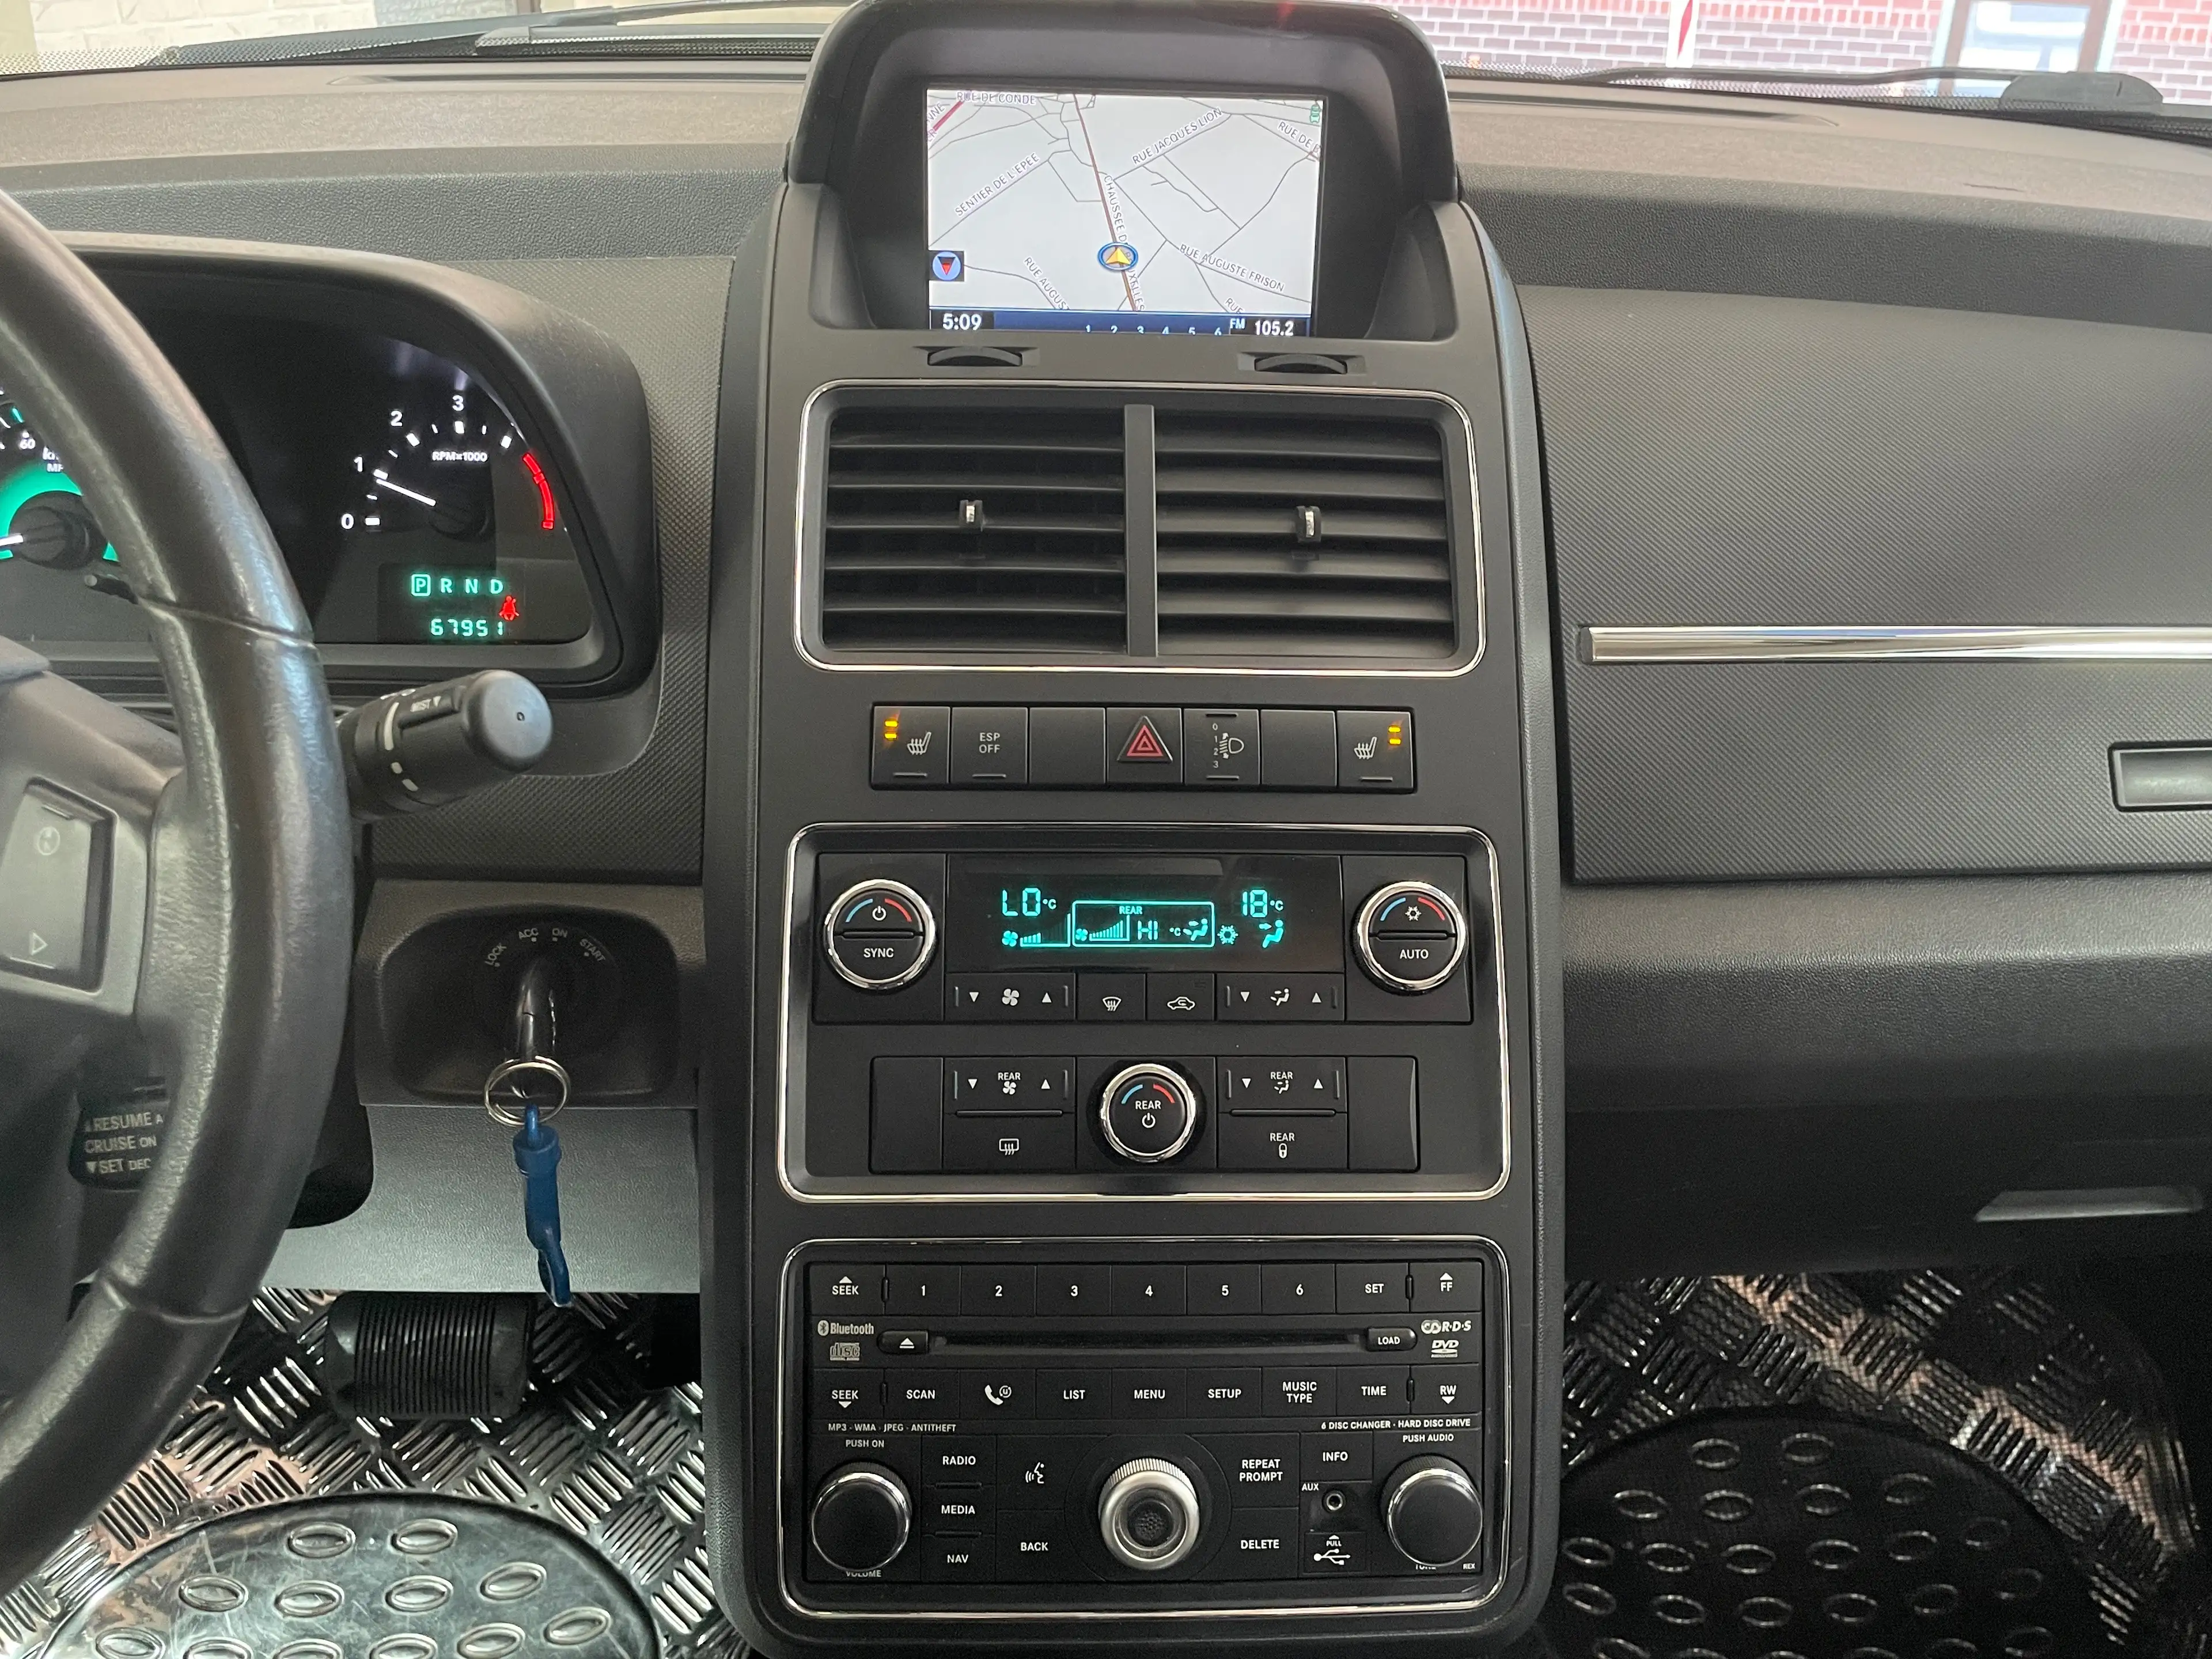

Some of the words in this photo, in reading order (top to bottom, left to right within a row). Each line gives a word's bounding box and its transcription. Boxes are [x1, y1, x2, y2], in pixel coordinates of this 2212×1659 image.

[957, 92, 977, 101] RUE
[982, 93, 993, 102] DE
[998, 93, 1036, 104] CONDE
[1132, 149, 1153, 164] RUE
[1154, 122, 1198, 154] JACQUES
[1199, 108, 1222, 127] LION
[1278, 122, 1297, 139] RUE
[1299, 134, 1312, 149] DE
[955, 186, 994, 216] SENTIER
[993, 175, 1007, 189] DE
[1007, 153, 1039, 179] L'EPEE
[1104, 175, 1126, 230] CHAUSSEE
[1024, 257, 1042, 278] RUE
[1180, 244, 1199, 259] RUE
[1202, 253, 1247, 277] AUGUSTE
[1249, 271, 1284, 292] FRISON
[1226, 298, 1243, 313] RUE
[942, 313, 982, 331] 5:09
[1230, 318, 1245, 329] FM
[1255, 320, 1294, 336] 105.2
[452, 395, 464, 411] 3
[390, 411, 403, 426] 2
[19, 438, 36, 449] 60
[354, 456, 363, 472] 1
[341, 513, 354, 529] 0
[416, 578, 426, 592] P
[440, 578, 452, 593] R
[465, 578, 478, 594] N
[490, 579, 503, 594] D
[431, 618, 503, 637] 67951
[1212, 722, 1218, 731] 0
[979, 732, 1001, 742] ESP
[1214, 735, 1218, 743] 1
[979, 744, 1001, 753] OFF
[1243, 889, 1268, 918] 18
[1119, 906, 1143, 915] REAR
[518, 927, 539, 940] ACC
[552, 927, 568, 938] ON
[484, 942, 507, 966] LOCK
[579, 938, 606, 962] START
[863, 948, 894, 958] SYNC
[1399, 949, 1429, 959] AUTO
[998, 1072, 1021, 1081] REAR
[1270, 1071, 1293, 1080] REAR
[1135, 1100, 1161, 1110] REAR
[92, 1112, 153, 1132] RESUME
[1270, 1132, 1295, 1142] REAR
[86, 1135, 136, 1154] CRUISE
[139, 1135, 157, 1149] ON
[99, 1158, 124, 1175] SET
[832, 1285, 859, 1295] SEEK
[921, 1285, 926, 1296] 1
[995, 1285, 1002, 1297] 2
[1070, 1285, 1078, 1297] 3
[1145, 1285, 1153, 1297] 4
[1221, 1285, 1229, 1296] 5
[1296, 1283, 1304, 1296] 6
[1365, 1283, 1384, 1294] SET
[1440, 1281, 1453, 1292] FF
[830, 1322, 874, 1335] Bluetooth
[1378, 1336, 1400, 1345] LOAD
[1431, 1340, 1459, 1349] DVD
[1282, 1381, 1317, 1392] MUSIC
[1361, 1385, 1387, 1396] TIME
[1440, 1385, 1457, 1395] RW
[831, 1389, 859, 1400] SEEK
[906, 1389, 935, 1399] SCAN
[1063, 1389, 1086, 1400] LIST
[1134, 1389, 1165, 1399] MENU
[1207, 1388, 1241, 1399] SETUP
[1286, 1393, 1312, 1403] TYPE
[828, 1423, 847, 1431] MP3
[854, 1423, 876, 1431] WMA
[883, 1423, 904, 1433] JPEG
[911, 1423, 956, 1432] ANTITHEFT
[1321, 1422, 1327, 1430] 6
[1328, 1421, 1349, 1430] DISC
[1350, 1420, 1391, 1429] CHANGER
[1398, 1419, 1422, 1428] HARD
[1423, 1419, 1444, 1427] DISC
[1445, 1418, 1471, 1427] DRIVE
[1403, 1434, 1425, 1443] PUSH
[1427, 1433, 1455, 1442] AUDIO
[846, 1440, 869, 1448] PUSH
[872, 1440, 884, 1448] ON
[942, 1456, 976, 1465] RADIO
[1323, 1451, 1348, 1461] INFO
[1242, 1459, 1281, 1469] REPEAT
[1239, 1471, 1283, 1482] PROMPT
[1301, 1483, 1319, 1491] AUX
[941, 1505, 975, 1514] MEDIA
[1020, 1541, 1048, 1551] BACK
[1240, 1539, 1279, 1550] DELETE
[1326, 1538, 1342, 1547] PULL
[947, 1554, 969, 1563] NAV
